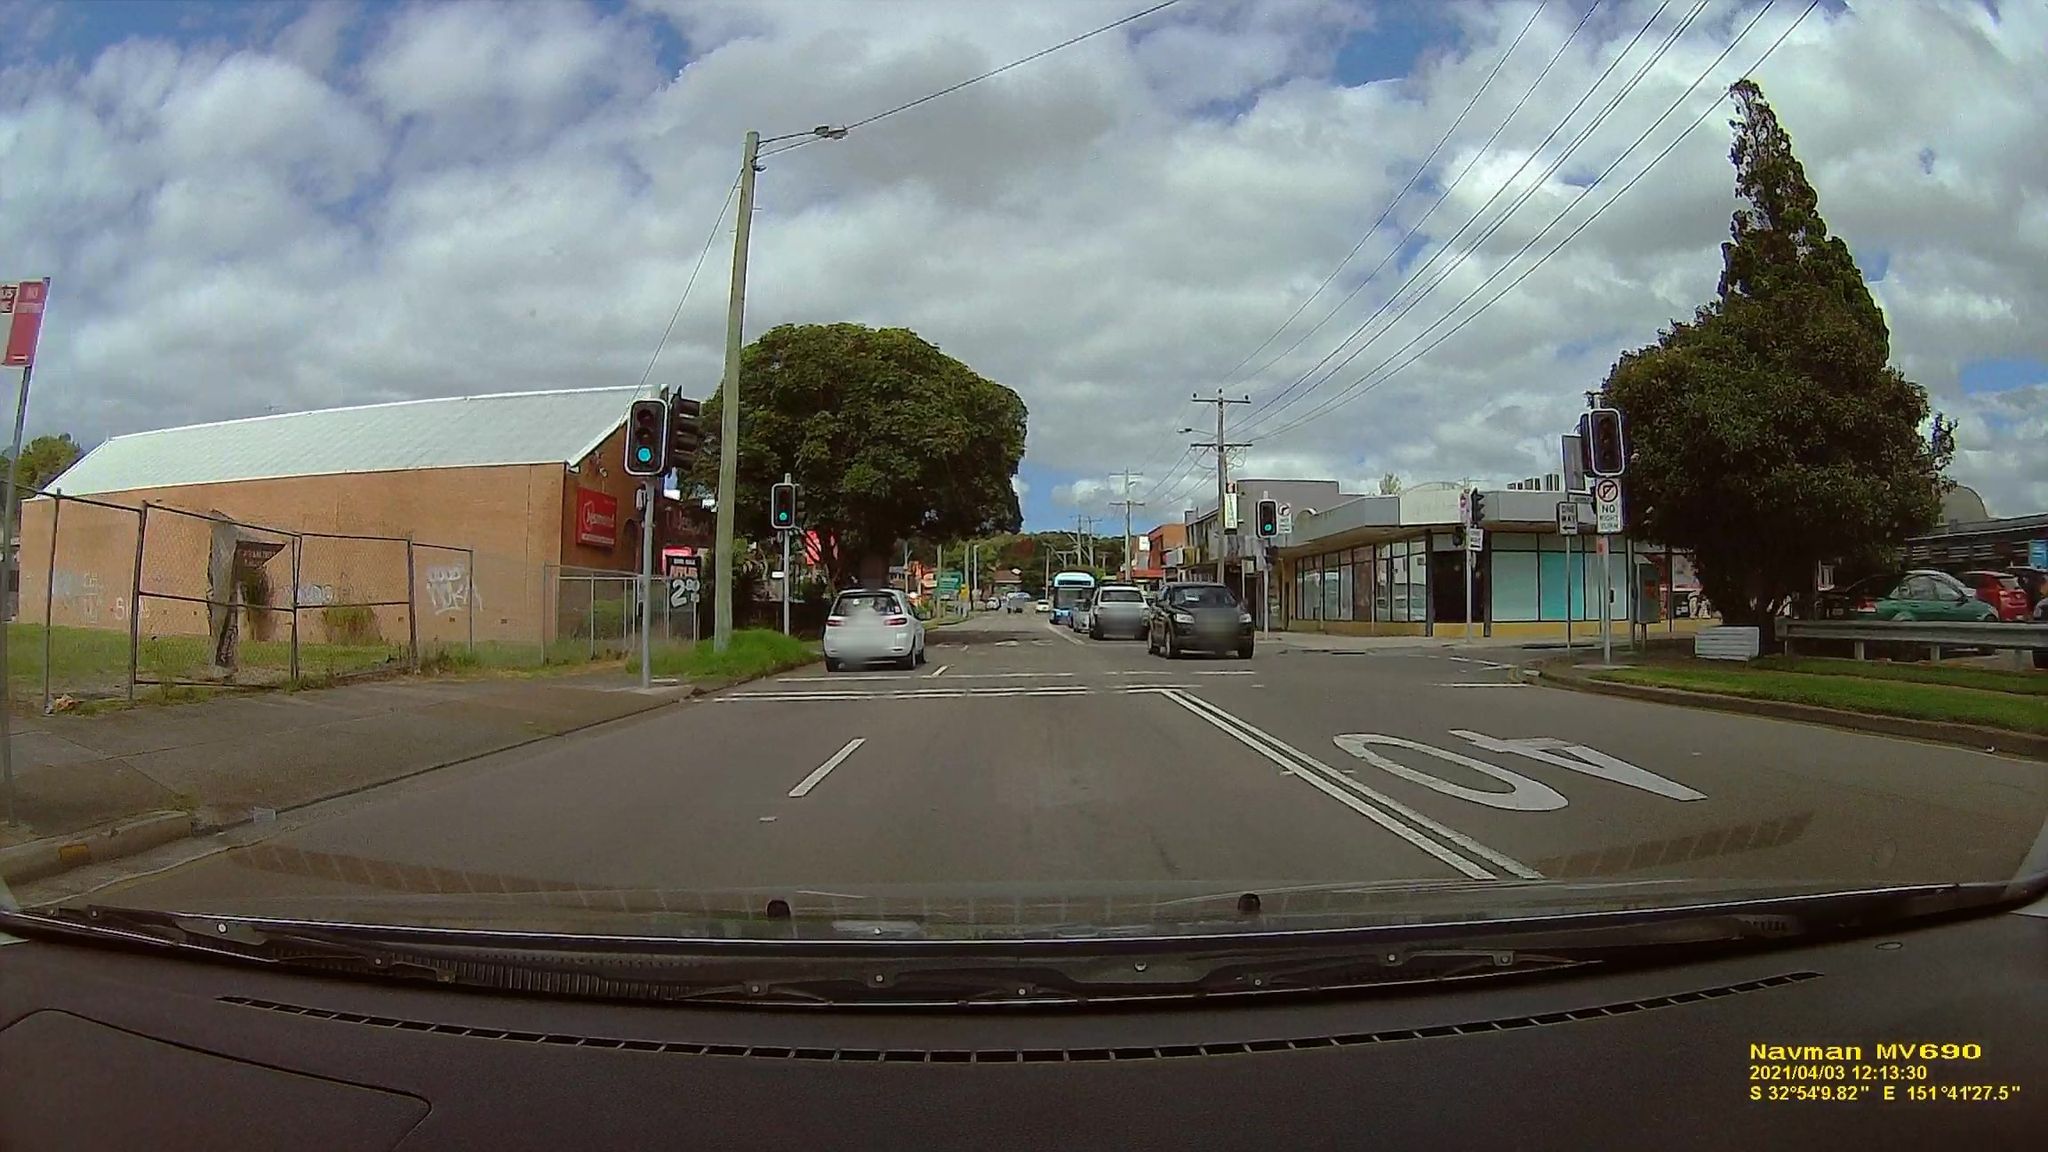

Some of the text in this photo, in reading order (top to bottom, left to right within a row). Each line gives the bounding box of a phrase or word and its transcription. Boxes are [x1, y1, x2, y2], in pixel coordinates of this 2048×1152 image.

[1561, 504, 1576, 514] ONE
[1601, 504, 1616, 514] NO
[1561, 514, 1577, 524] WAY
